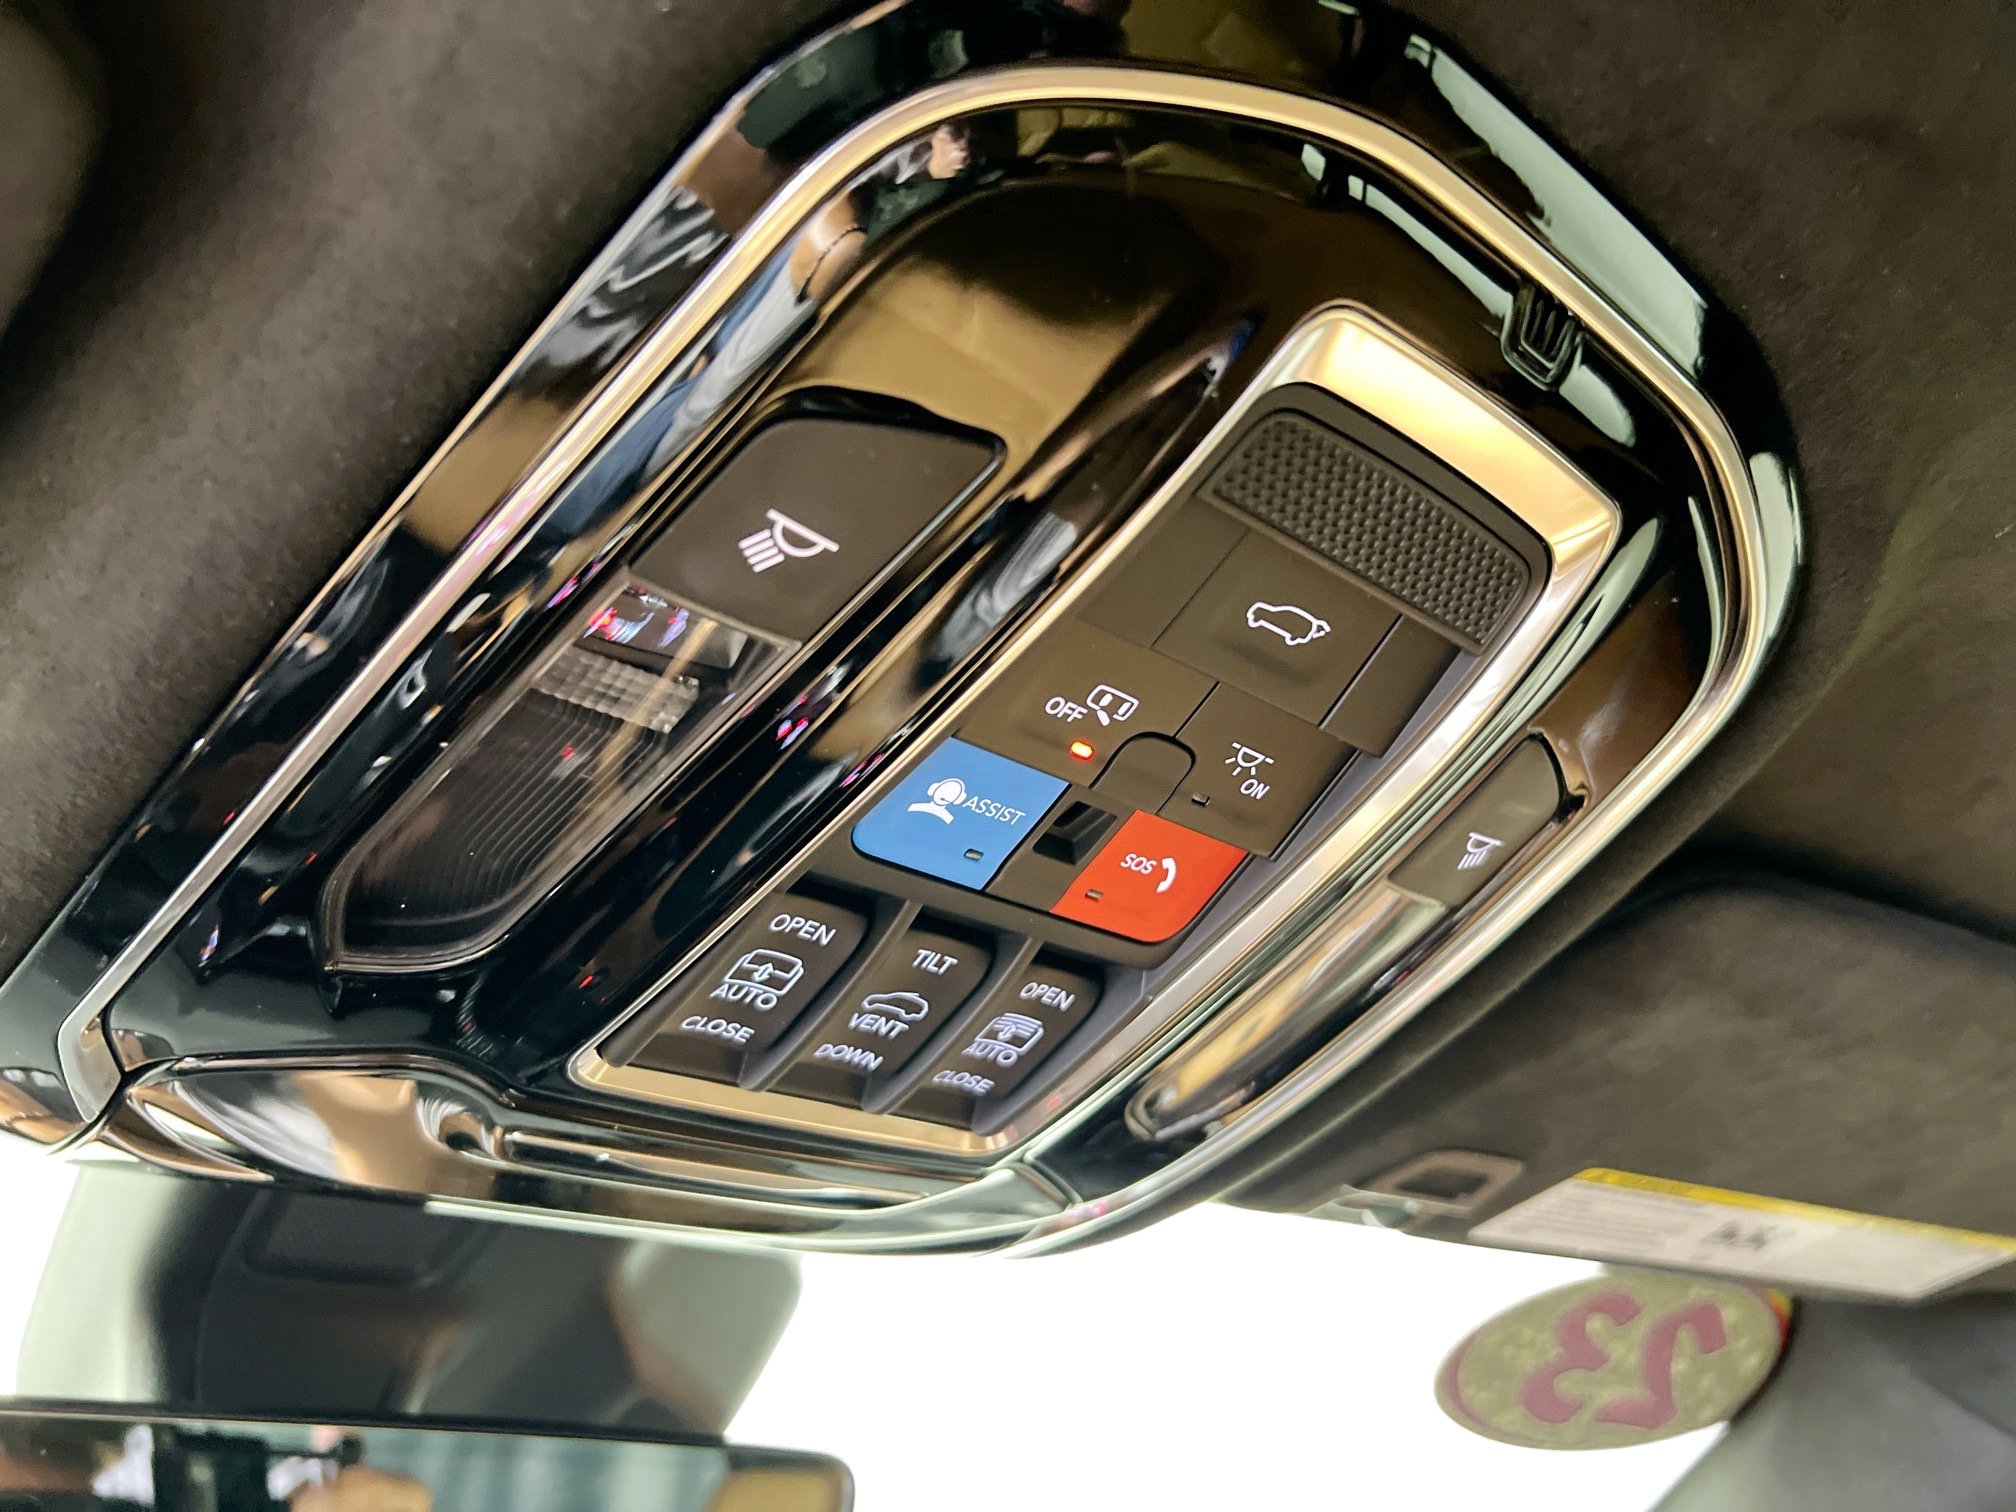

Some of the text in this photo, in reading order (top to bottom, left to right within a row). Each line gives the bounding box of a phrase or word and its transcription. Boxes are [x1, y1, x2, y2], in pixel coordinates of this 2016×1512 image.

[1044, 697, 1089, 724] OFF
[1240, 778, 1271, 800] ON
[962, 796, 1026, 826] ASSIST
[1120, 853, 1157, 875] SOS
[768, 914, 836, 946] OPEN
[911, 948, 959, 976] TILT
[709, 983, 778, 1012] AUTO
[1019, 982, 1075, 1012] OPEN
[680, 1015, 755, 1045] CLOSE
[847, 1013, 909, 1040] VENT
[813, 1043, 884, 1071] DOWN
[961, 1041, 1019, 1069] AUTO
[932, 1069, 996, 1097] CLOSE
